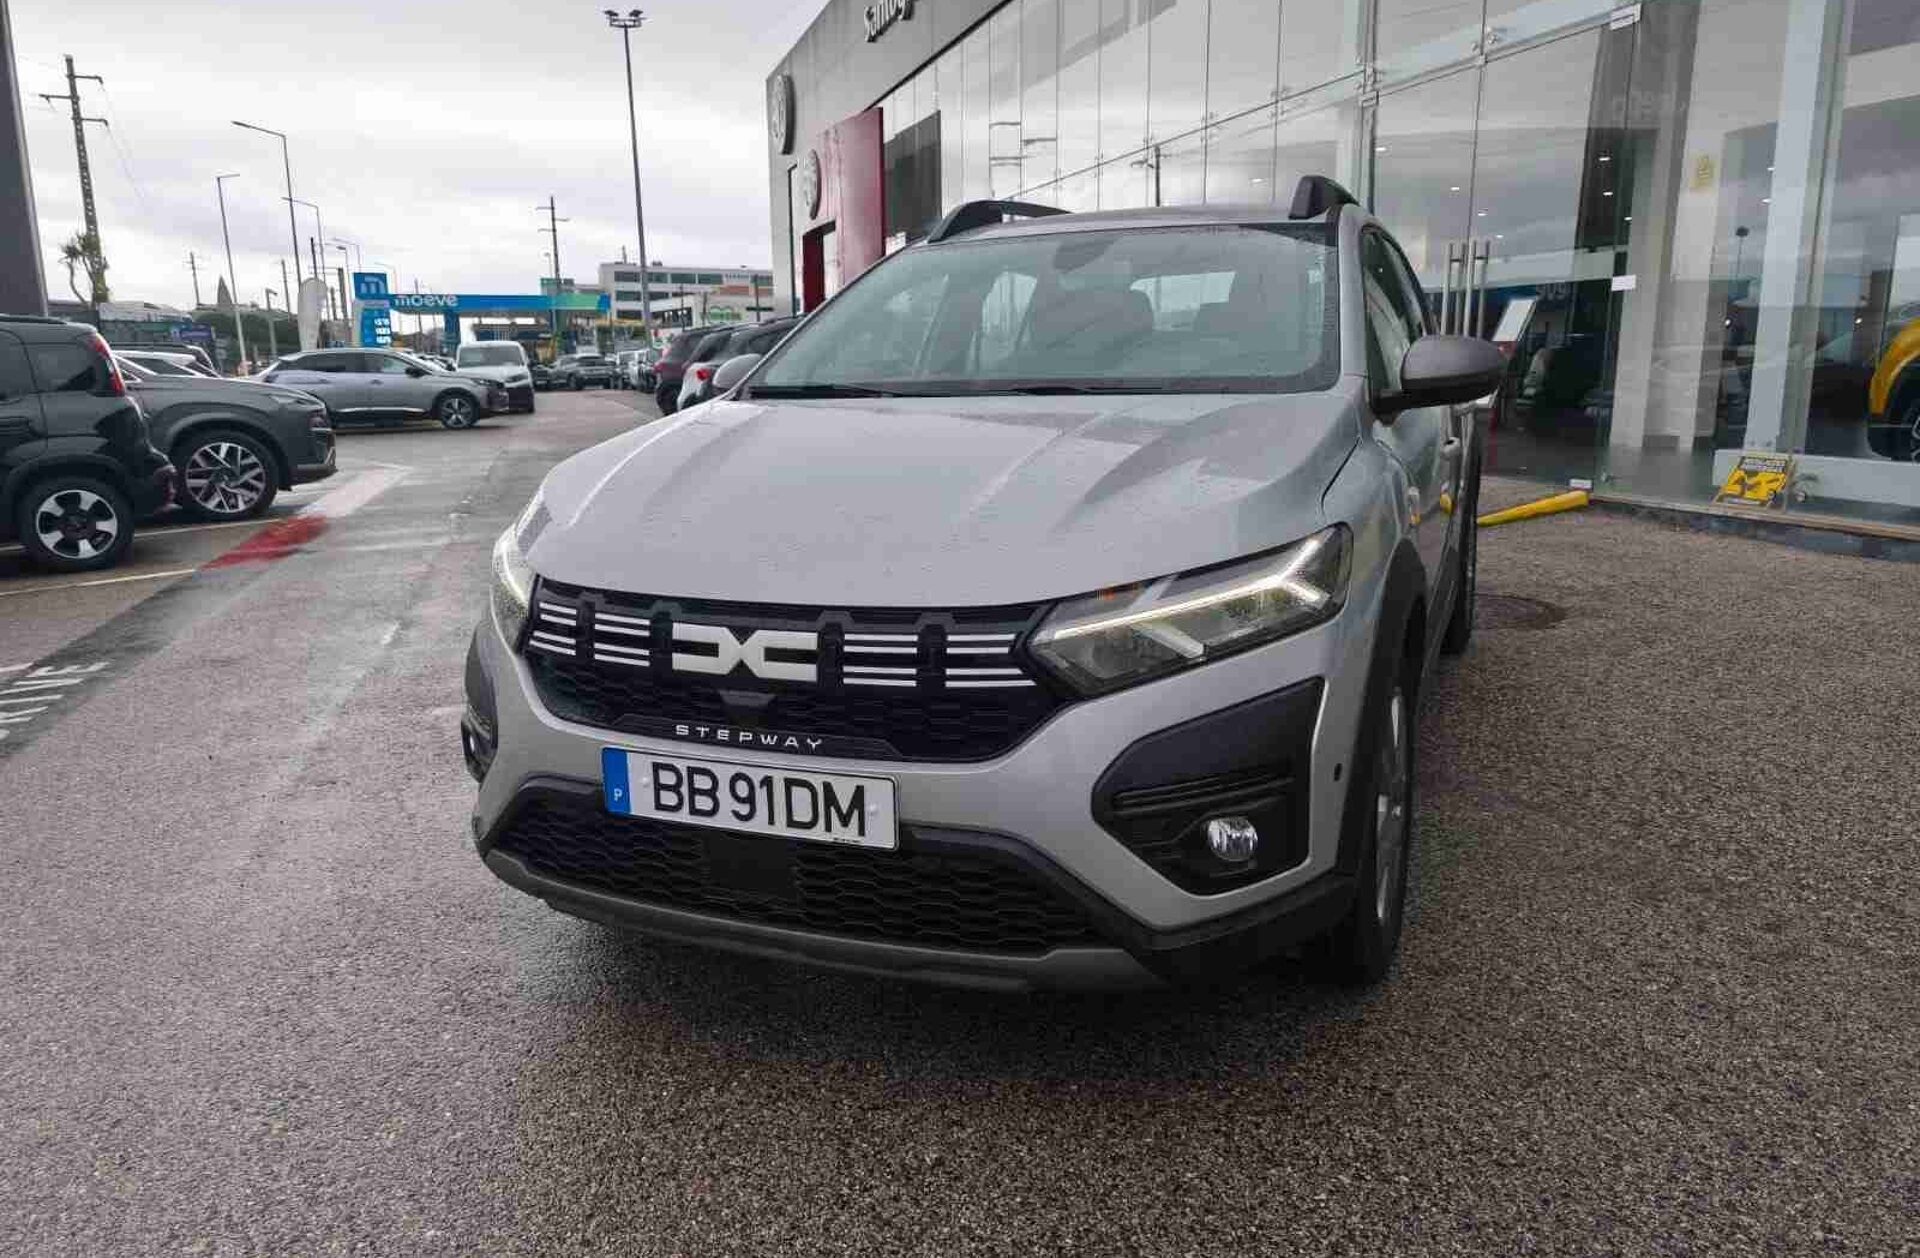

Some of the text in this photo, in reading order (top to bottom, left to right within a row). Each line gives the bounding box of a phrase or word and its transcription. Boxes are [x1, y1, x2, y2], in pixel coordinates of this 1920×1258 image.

[394, 294, 459, 307] moeve
[675, 724, 823, 750] STEPWAY
[613, 788, 623, 802] P
[651, 761, 866, 838] BB 91 DM
